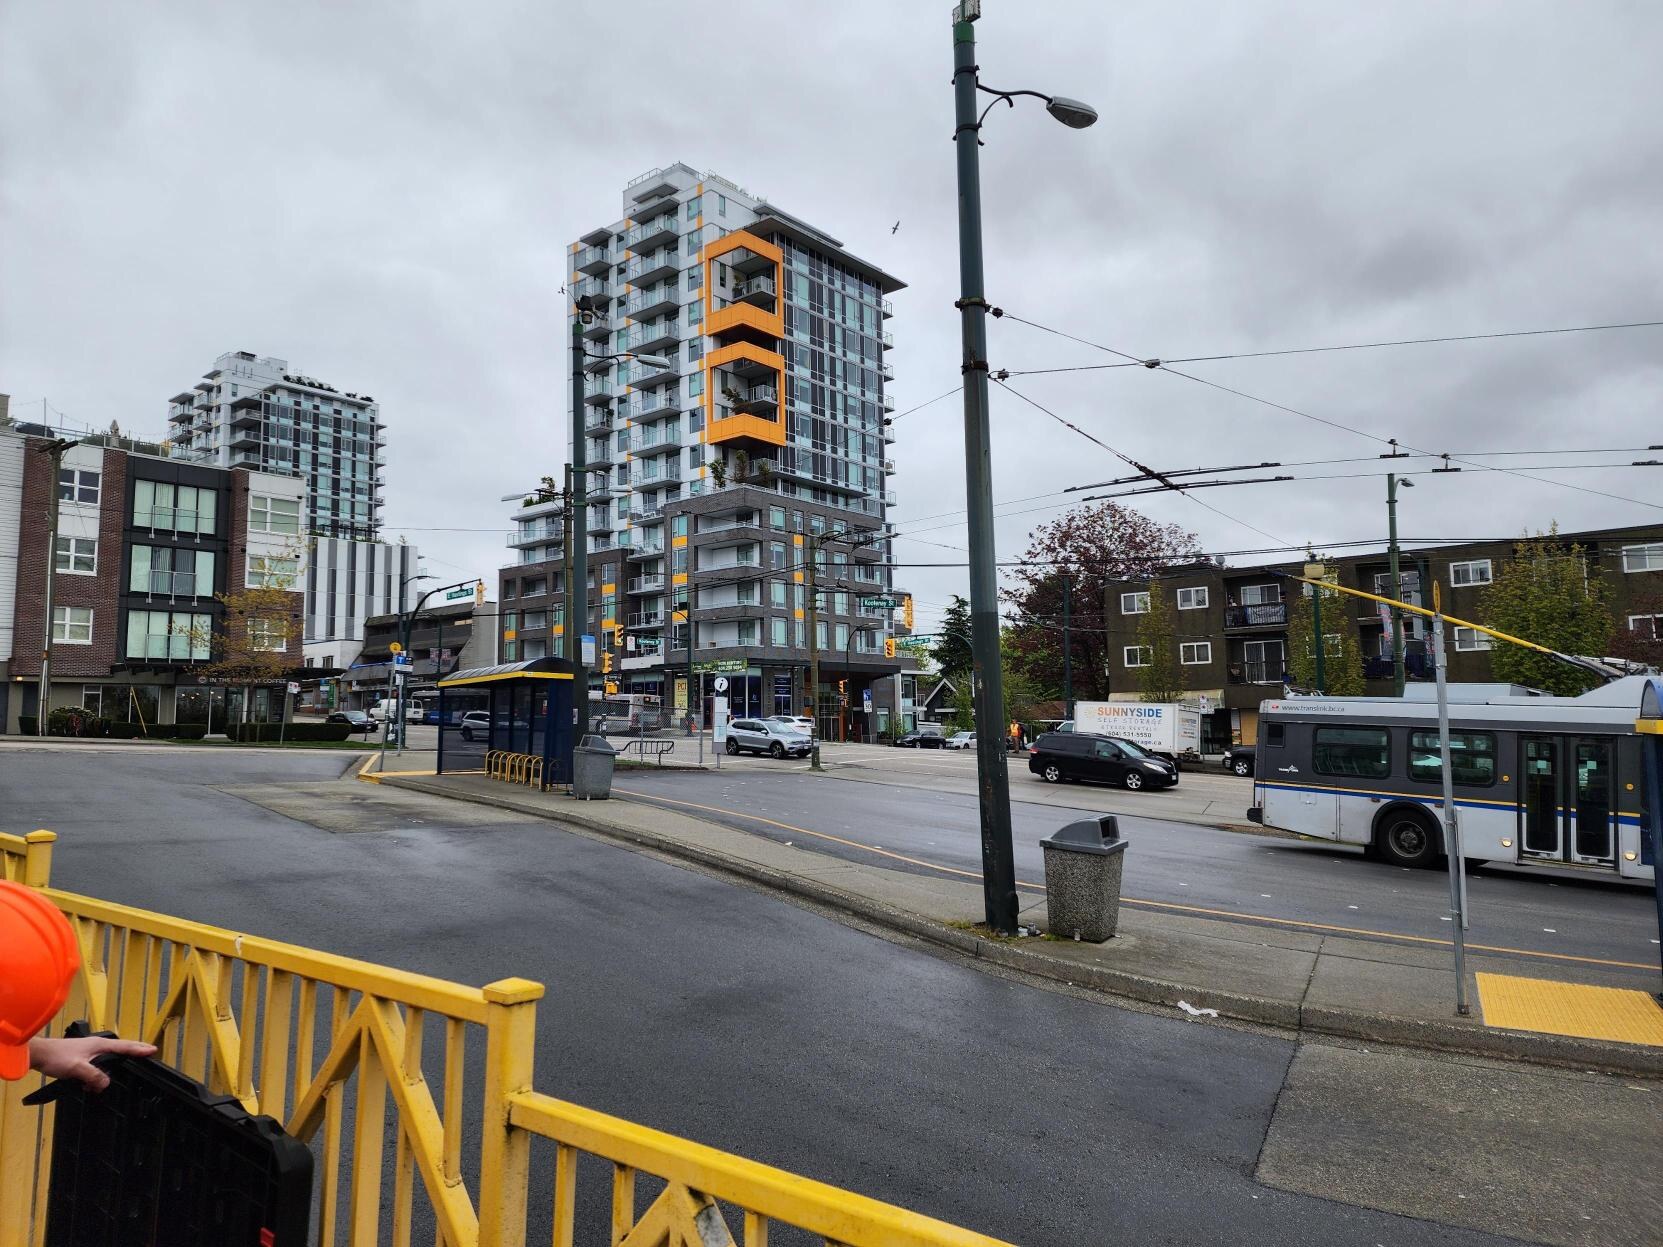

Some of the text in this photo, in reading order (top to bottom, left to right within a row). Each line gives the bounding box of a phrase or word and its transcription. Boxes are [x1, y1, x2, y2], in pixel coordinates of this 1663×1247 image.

[864, 599, 887, 607] Kootenay
[1097, 706, 1162, 718] SUNNYSIDE
[1122, 717, 1162, 726] STORAGE
